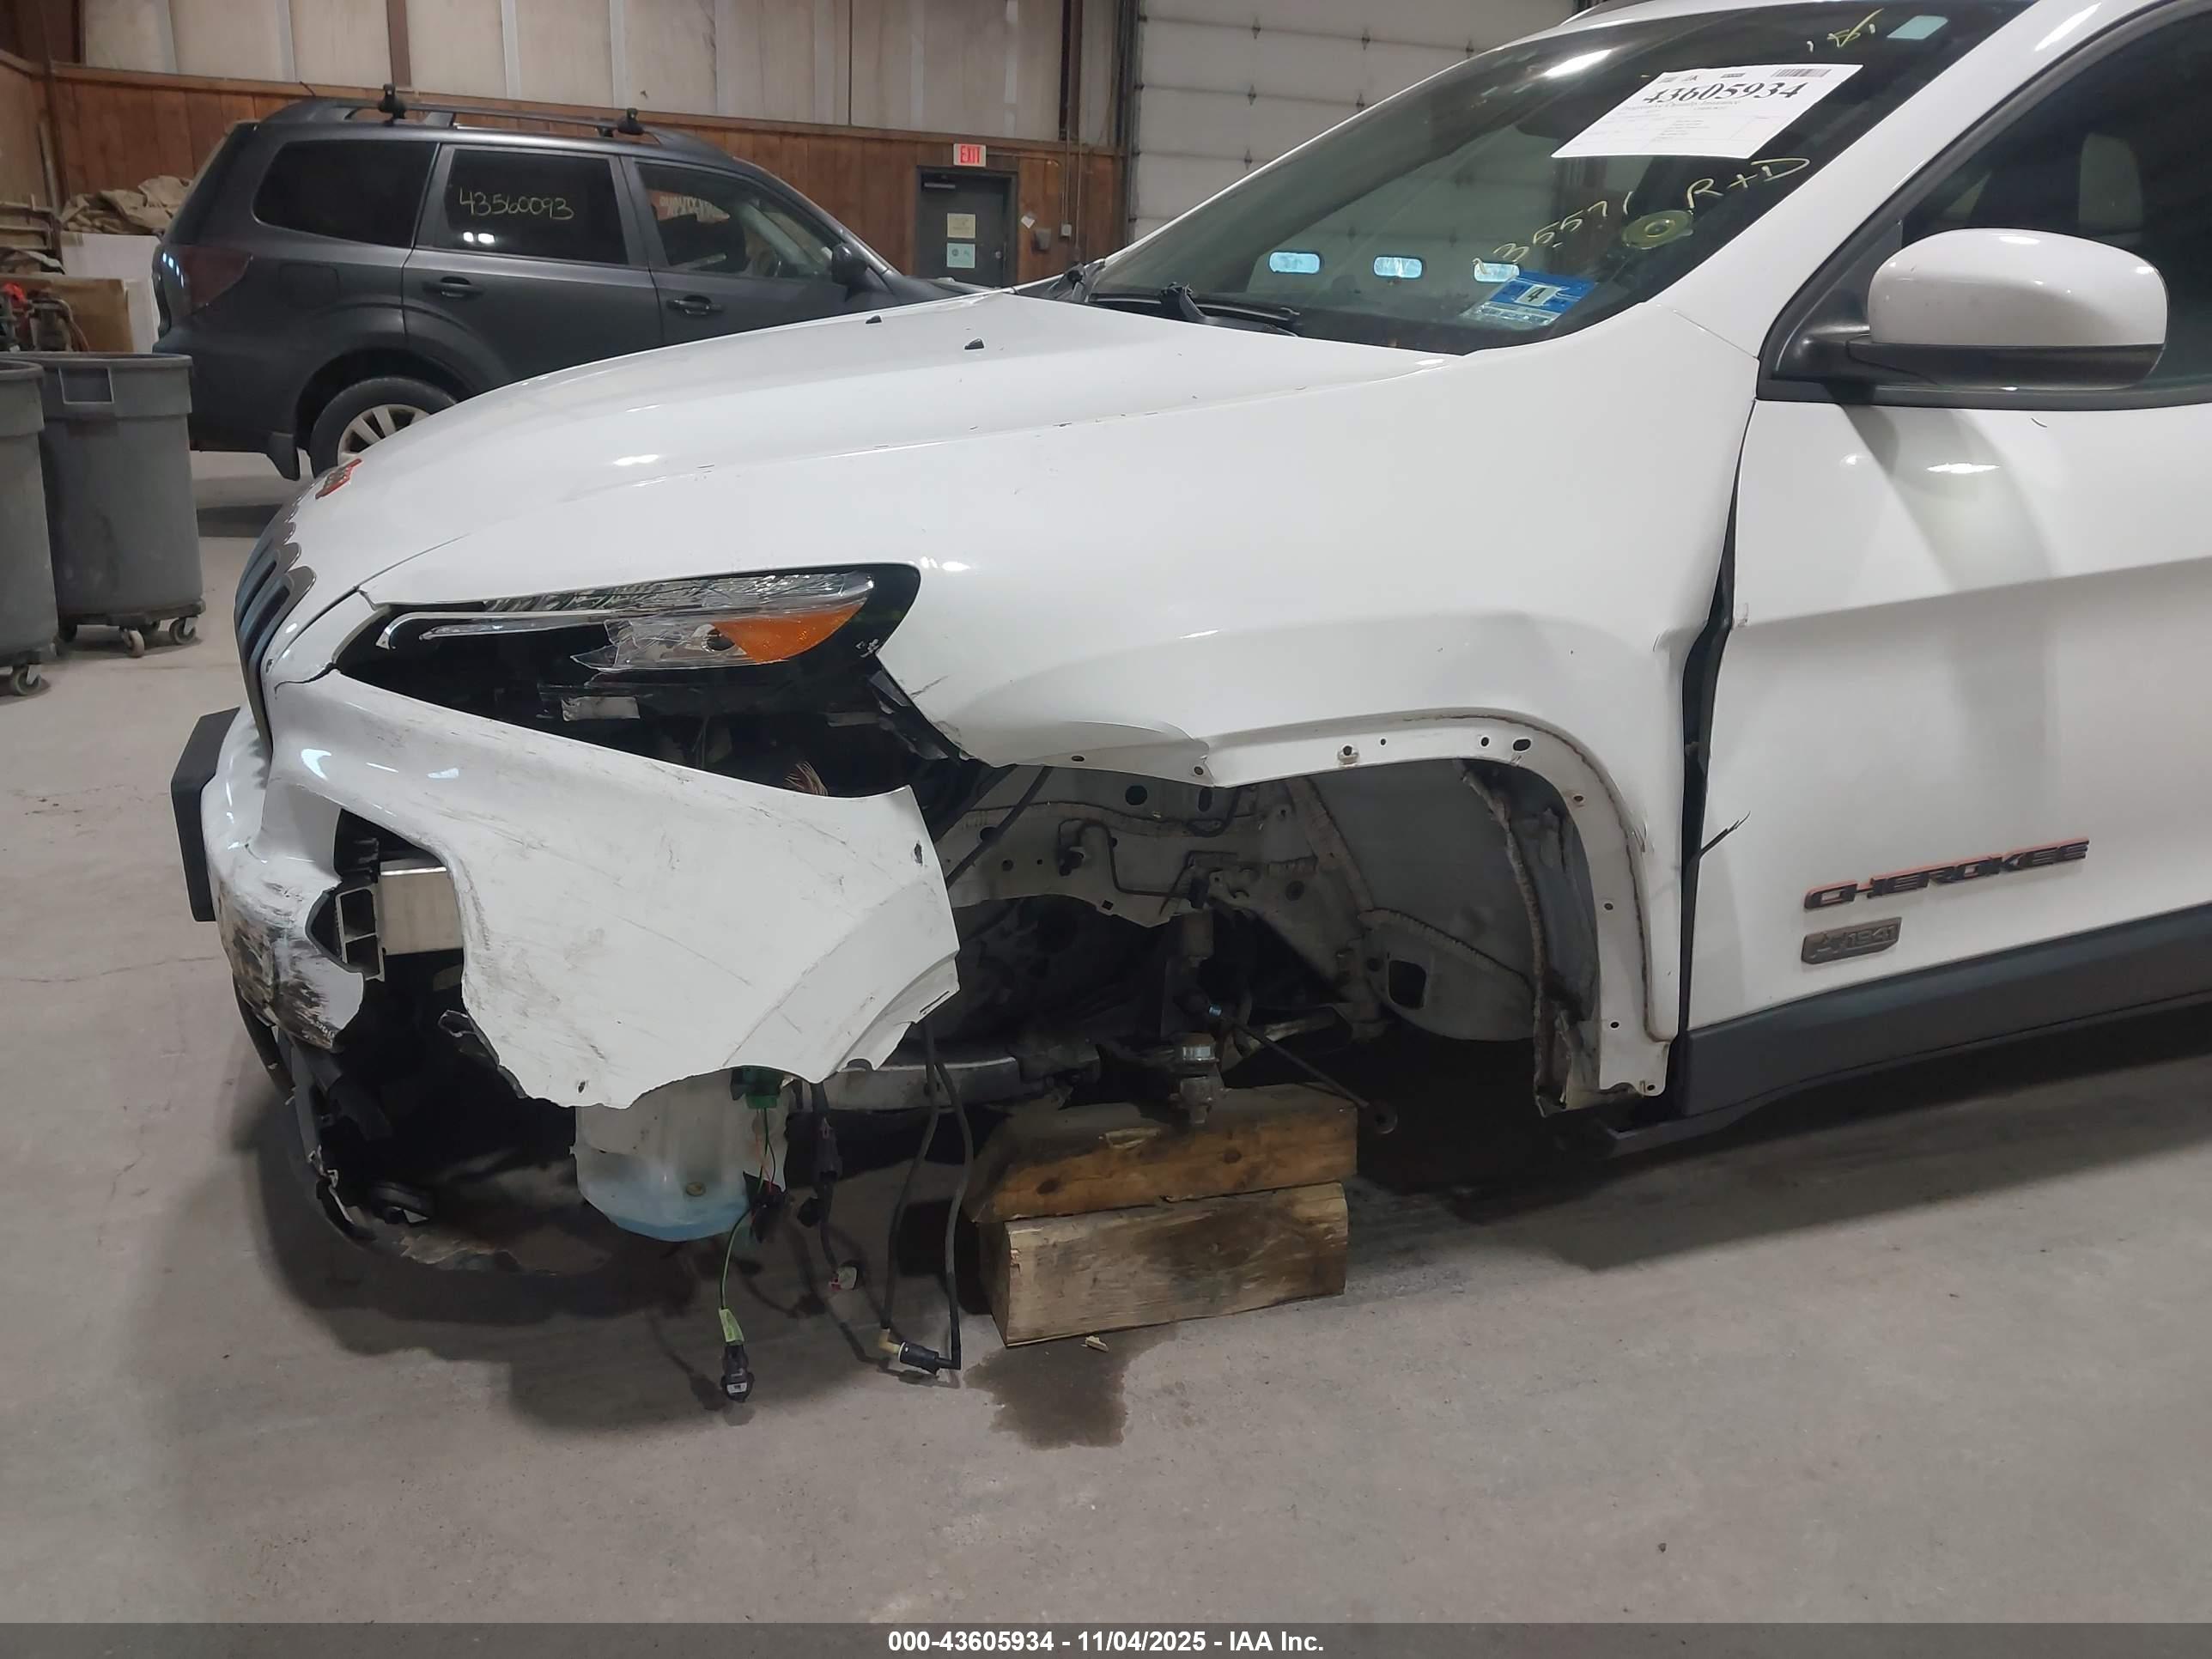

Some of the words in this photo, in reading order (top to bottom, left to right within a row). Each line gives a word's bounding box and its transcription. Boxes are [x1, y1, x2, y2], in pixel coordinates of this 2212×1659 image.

[1643, 82, 1808, 103] 43605934
[960, 144, 980, 163] EXIT
[459, 187, 574, 220] 43560093
[1803, 838, 2089, 910] CHEROKEE
[1846, 926, 1897, 950] 1941
